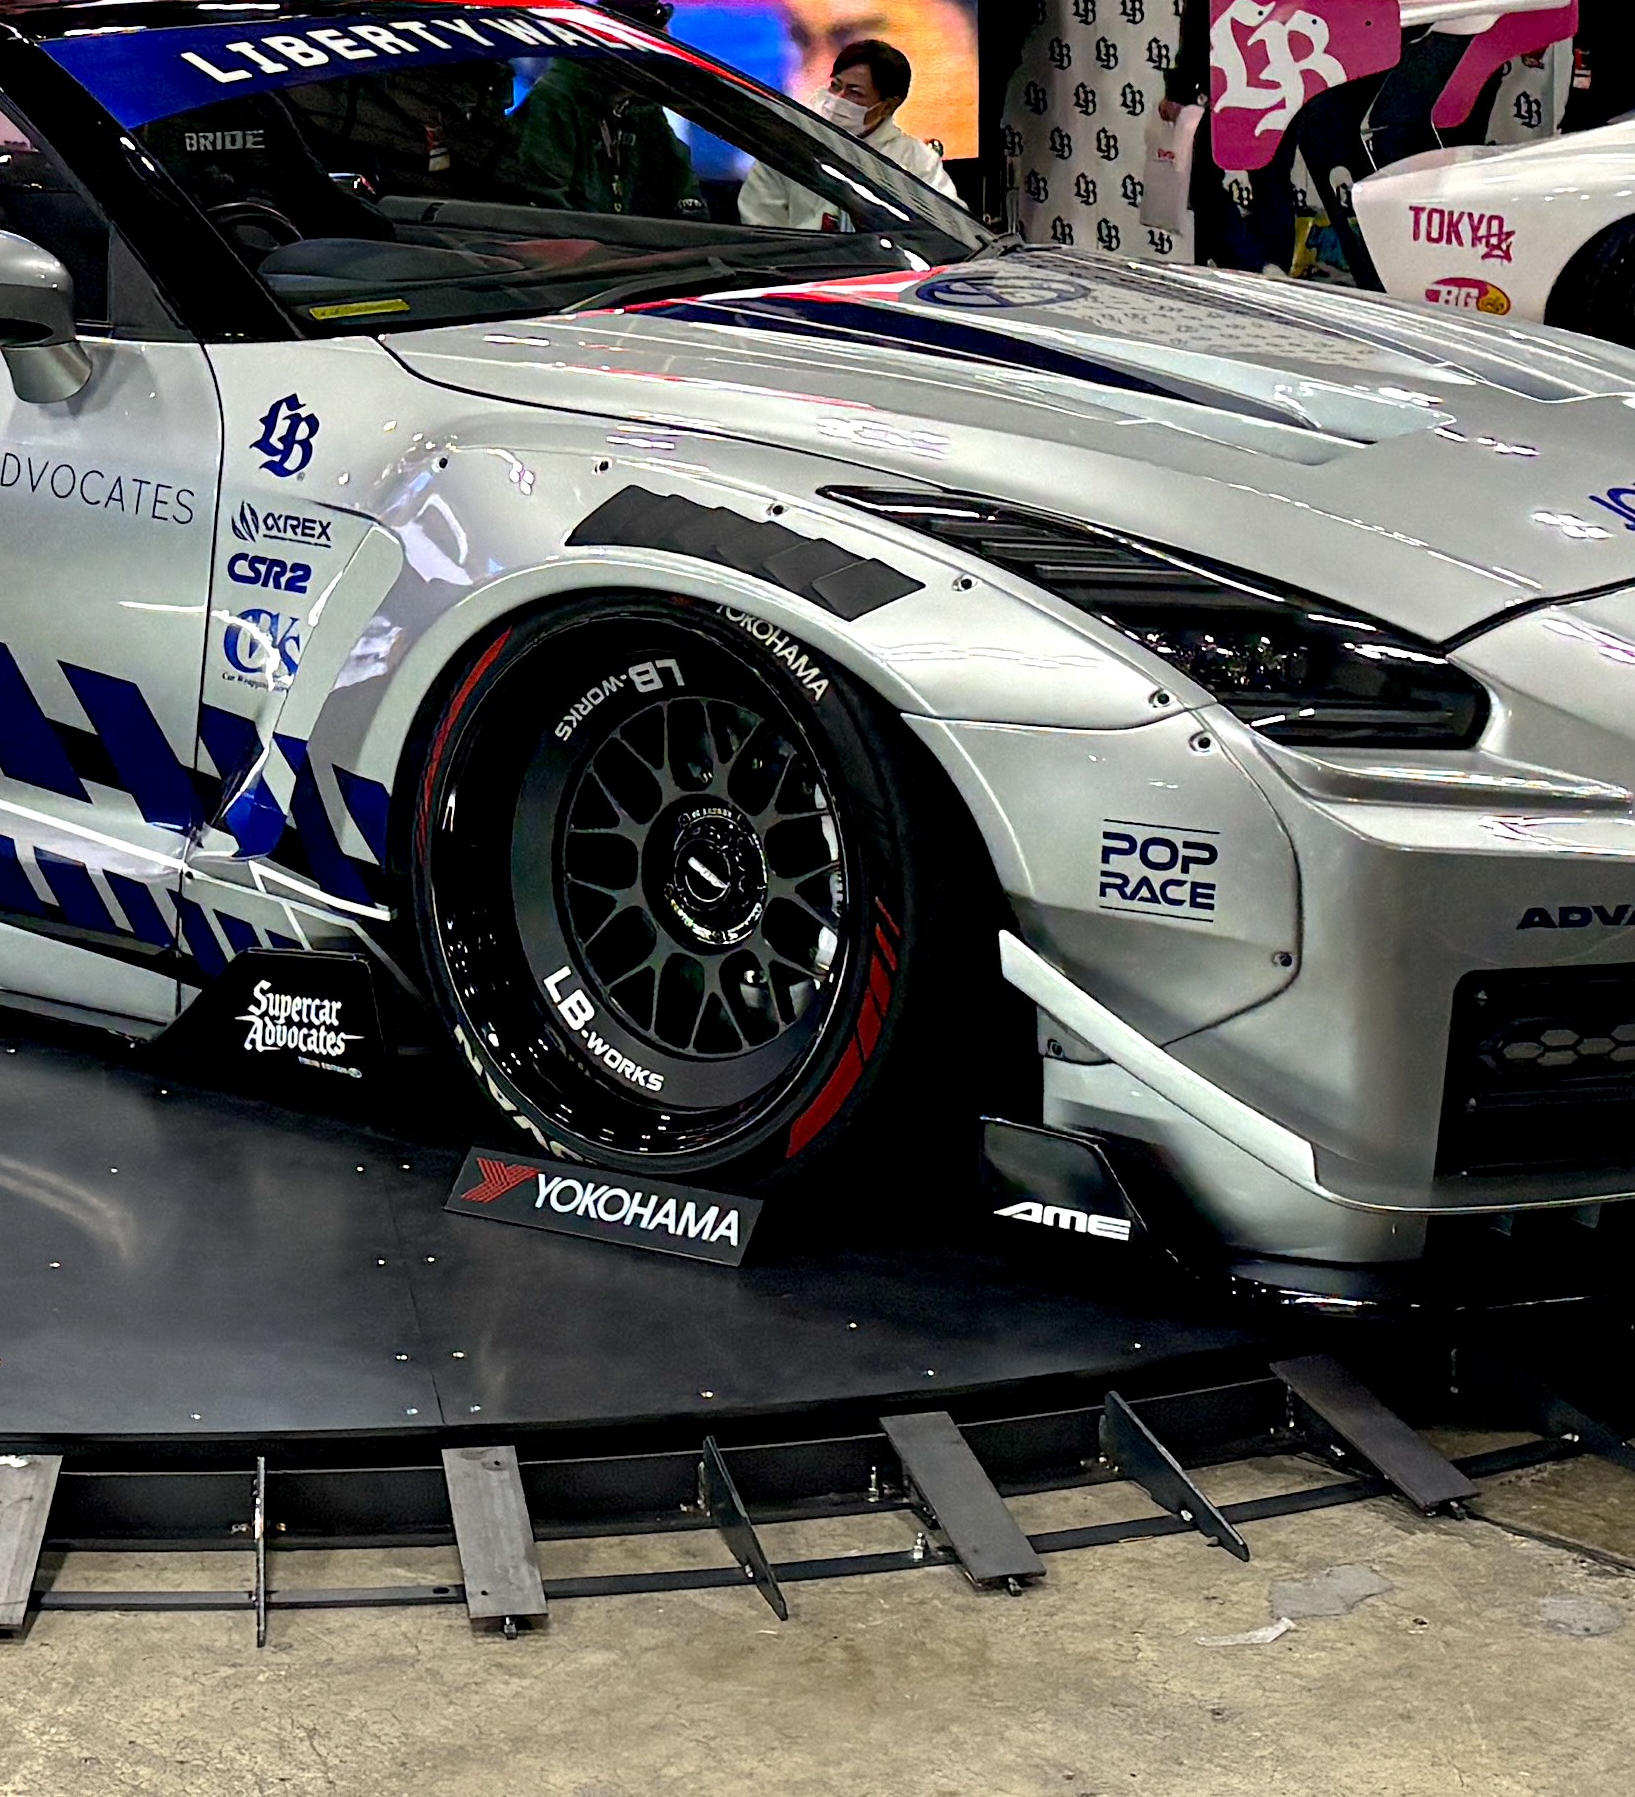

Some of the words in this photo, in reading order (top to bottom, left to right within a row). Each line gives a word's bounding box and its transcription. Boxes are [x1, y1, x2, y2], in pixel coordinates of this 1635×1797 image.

[180, 17, 495, 85] LIBERTY
[184, 130, 264, 152] BRIDE
[1409, 205, 1504, 249] TOKYO
[248, 393, 321, 479] LB
[227, 552, 312, 594] CSR2
[1101, 831, 1219, 876] POP
[1099, 871, 1216, 911] RACE
[247, 980, 342, 1026] Supercar
[234, 1014, 365, 1057] Advocates
[535, 1174, 740, 1247] YOKOHAMA
[993, 1201, 1131, 1243] AME
